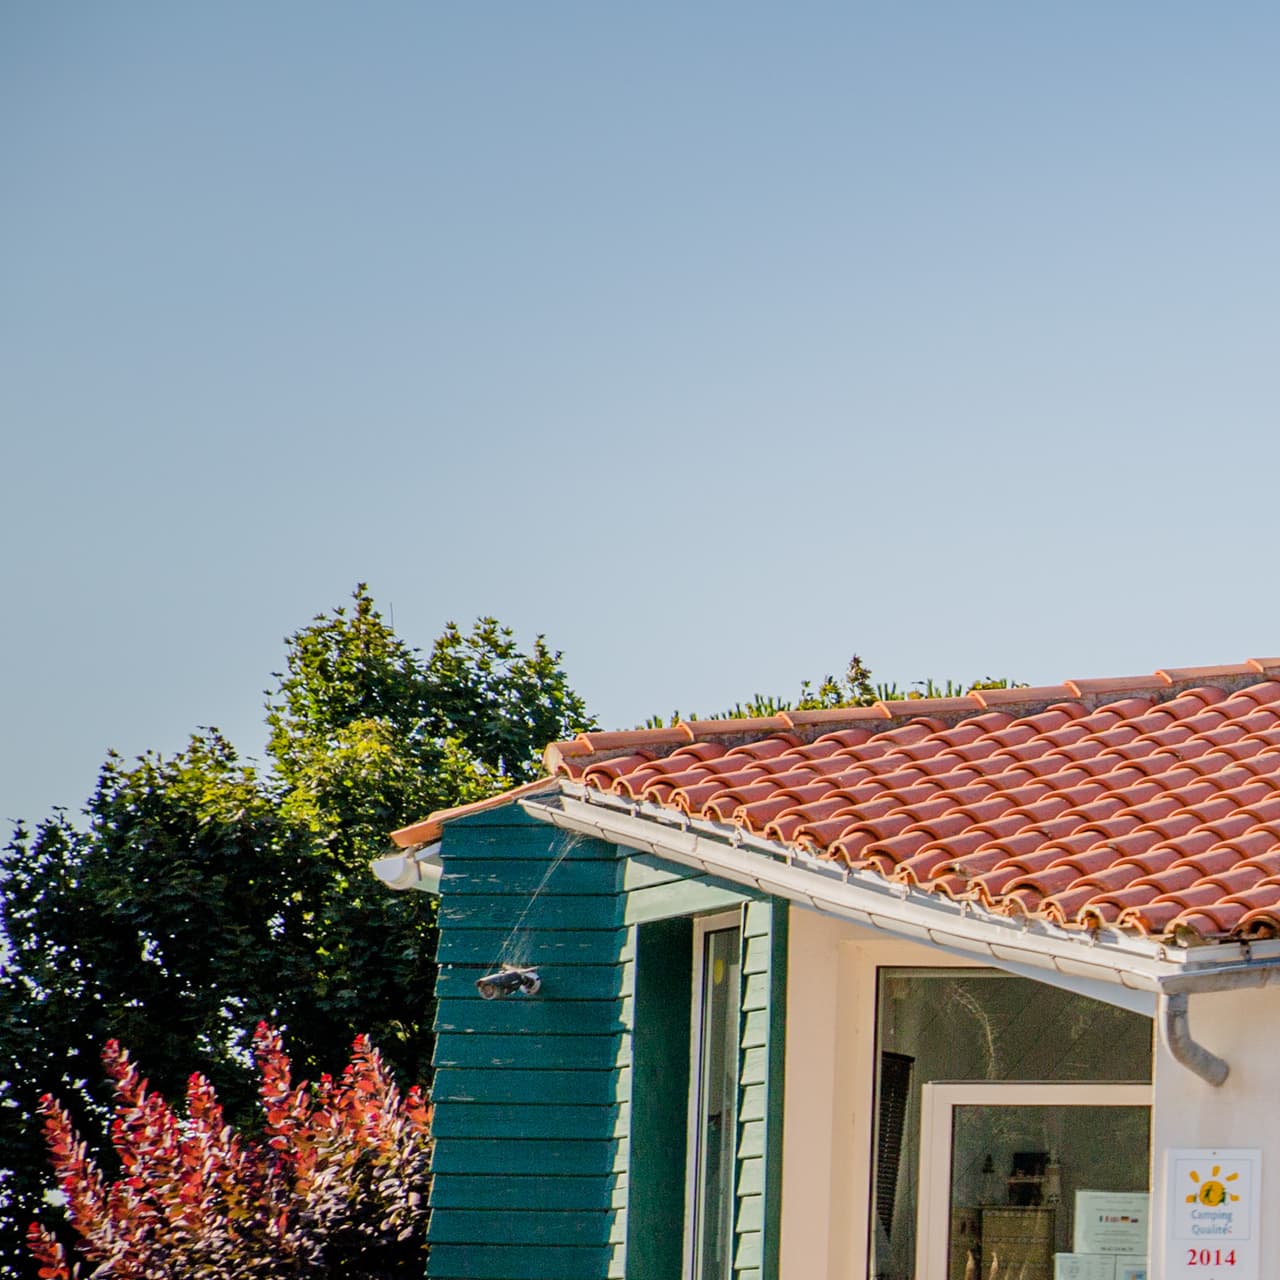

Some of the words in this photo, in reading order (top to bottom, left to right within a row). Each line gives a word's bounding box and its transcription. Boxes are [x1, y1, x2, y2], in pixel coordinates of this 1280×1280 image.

[1191, 1209, 1233, 1222] Camping
[1191, 1222, 1229, 1236] Qualité
[1187, 1248, 1237, 1266] 2014
